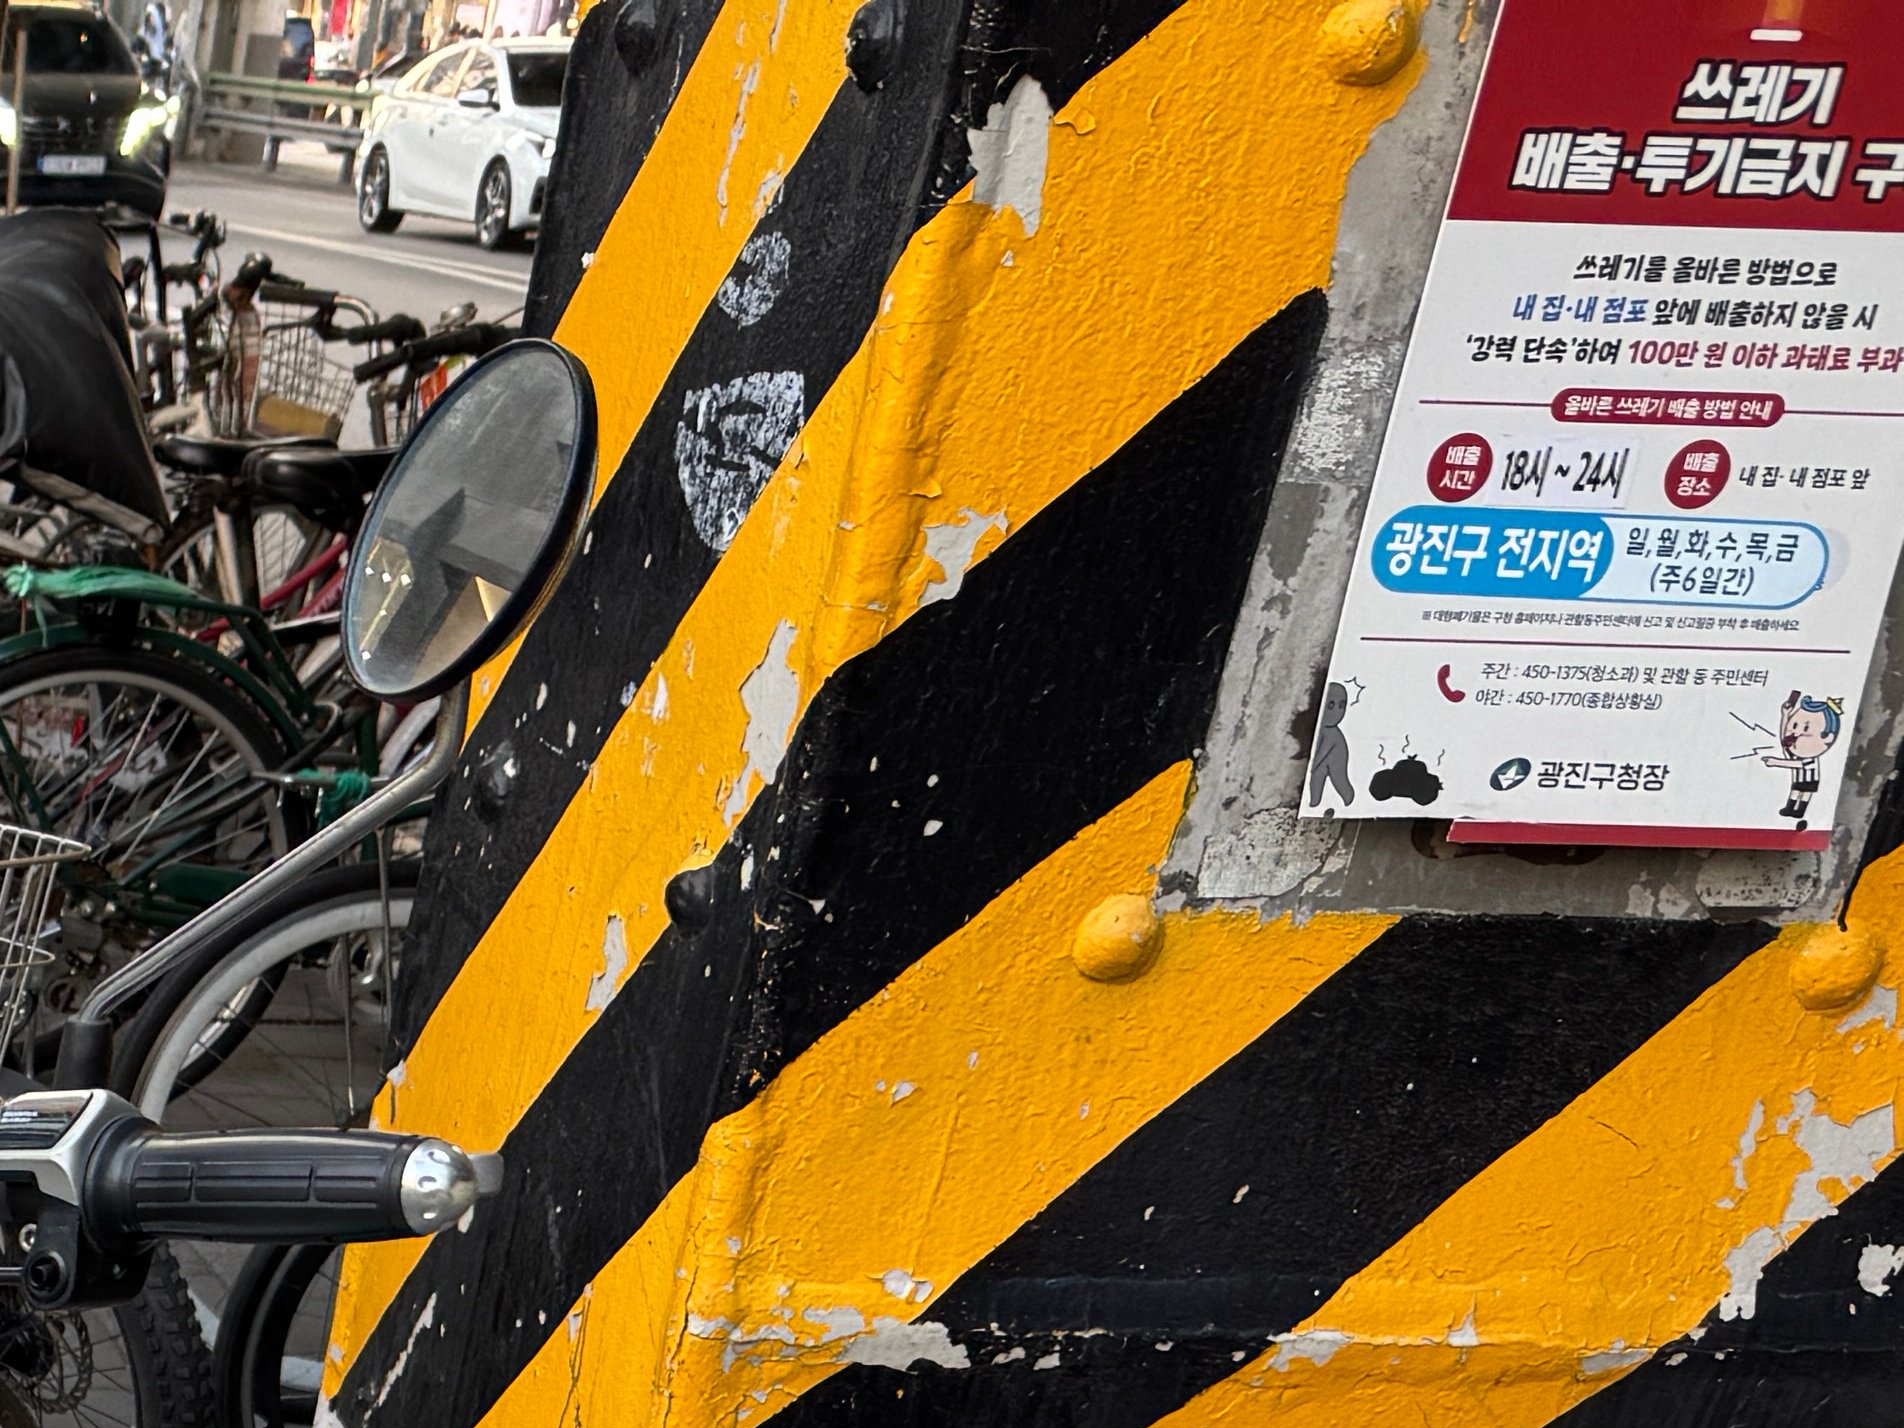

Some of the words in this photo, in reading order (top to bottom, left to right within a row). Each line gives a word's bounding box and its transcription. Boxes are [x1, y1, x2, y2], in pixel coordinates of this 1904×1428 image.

[1674, 61, 1845, 126] 쓰레기
[1510, 130, 1850, 198] 배출·투기금지
[1573, 254, 1668, 284] 쓰레기를
[1673, 256, 1741, 286] 올바른
[1746, 257, 1838, 288] 방법으로
[1512, 293, 1538, 321] 내
[1603, 297, 1649, 324] 점포
[1652, 298, 1702, 326] 앞에
[1705, 300, 1798, 329] 배출하지
[1801, 302, 1849, 331] 않을
[1852, 304, 1879, 331] 시
[1628, 340, 1697, 368] 100만
[1703, 343, 1728, 369] 원
[1732, 344, 1778, 371] 이하
[1781, 344, 1852, 371] 과태료
[1563, 394, 1613, 417] 올바른
[1615, 396, 1665, 419] 쓰레기
[1667, 397, 1701, 420] 배출
[1703, 399, 1739, 420] 방법
[1741, 401, 1774, 422] 안내
[1438, 468, 1478, 492] 시간
[1446, 445, 1480, 466] 배출
[1500, 447, 1551, 496] 18시
[1572, 447, 1631, 499] 24시
[1682, 450, 1721, 472] 배출
[1676, 475, 1715, 499] 장소
[1737, 465, 1759, 487] 내
[1789, 466, 1809, 489] 내
[1810, 467, 1849, 489] 점포
[1850, 468, 1872, 491] 앞
[1385, 521, 1492, 578] 광진구
[1497, 527, 1604, 584] 전지역
[1625, 526, 1799, 563] 일,월,화,수,목,금
[1481, 663, 1511, 680] 주간
[1643, 667, 1658, 685] 및
[1661, 667, 1690, 686] 관할
[1693, 668, 1708, 687] 동
[1710, 669, 1769, 688] 주민센터
[1475, 689, 1505, 706] 야간
[1537, 761, 1672, 792] 광진구청장
